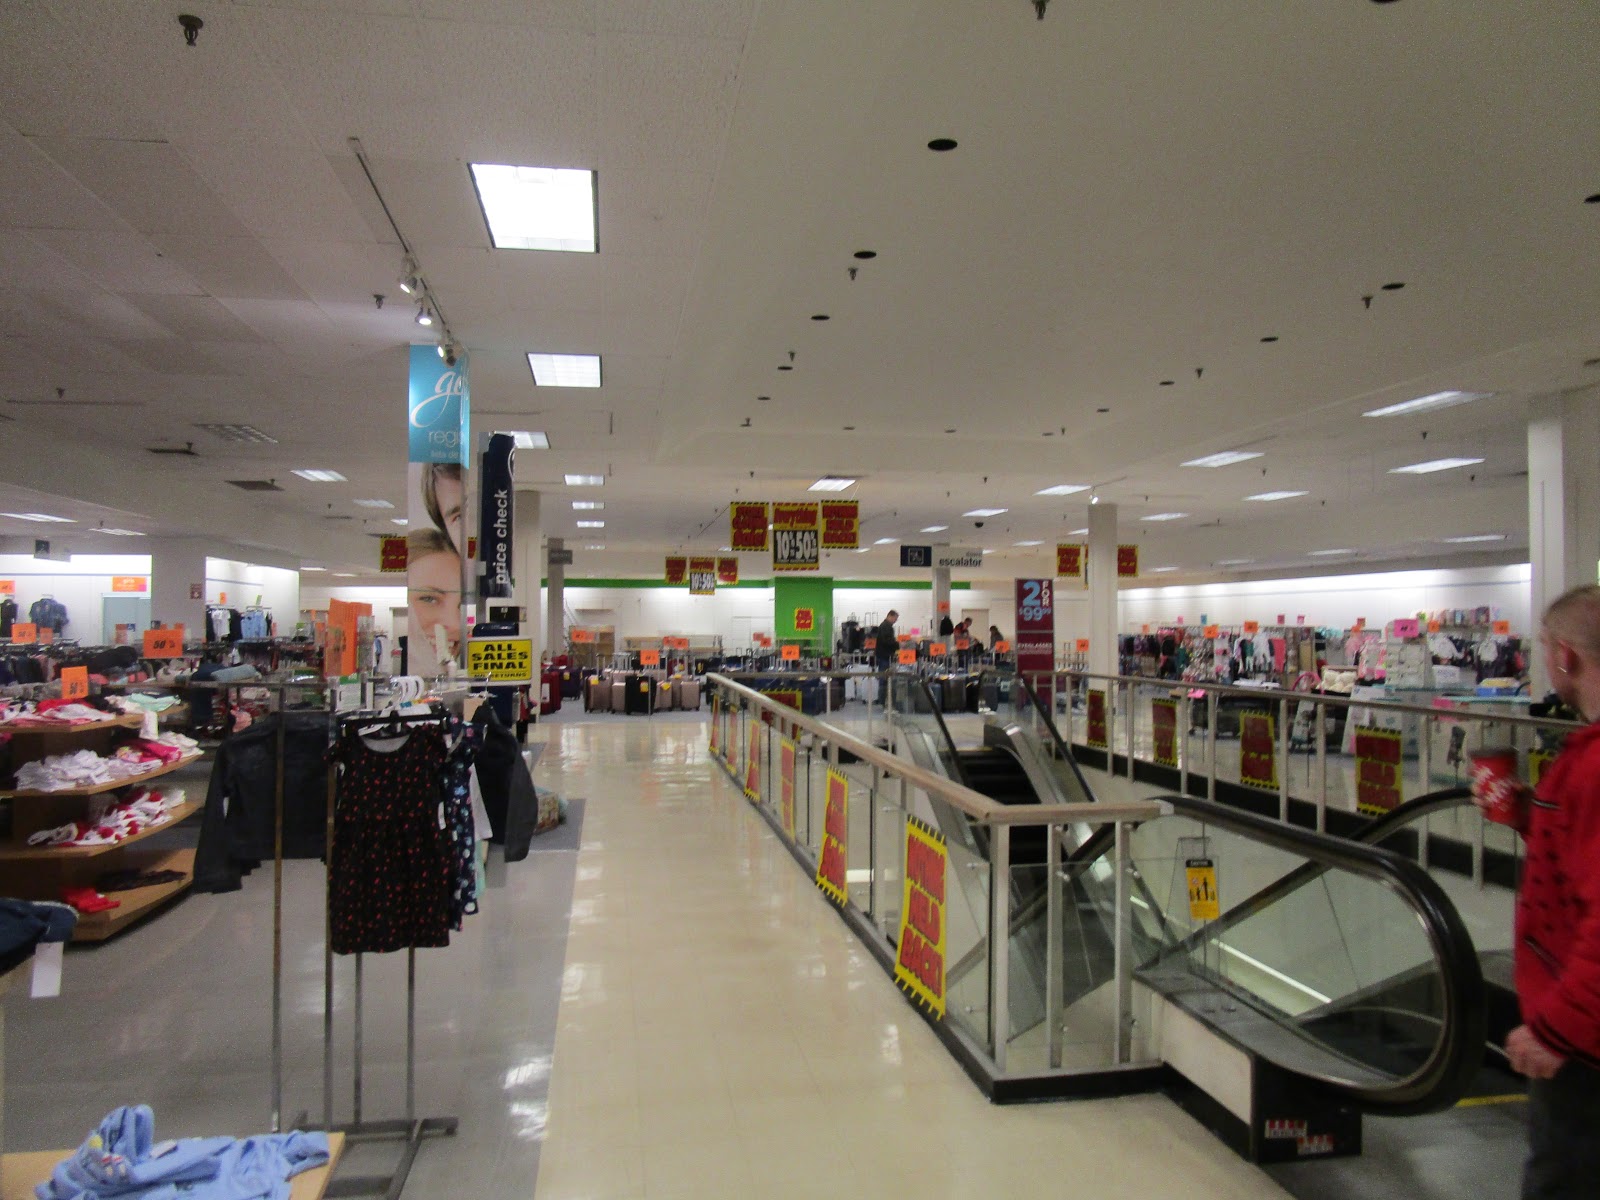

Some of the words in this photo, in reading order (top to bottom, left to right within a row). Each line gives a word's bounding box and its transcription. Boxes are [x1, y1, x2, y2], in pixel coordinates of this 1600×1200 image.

[494, 489, 507, 538] check
[493, 543, 507, 584] price
[939, 557, 982, 567] escalator
[1023, 581, 1040, 606] 2
[1041, 581, 1050, 606] FOR
[484, 644, 516, 652] ALL
[472, 652, 528, 661] SALES
[473, 662, 526, 670] FINAL
